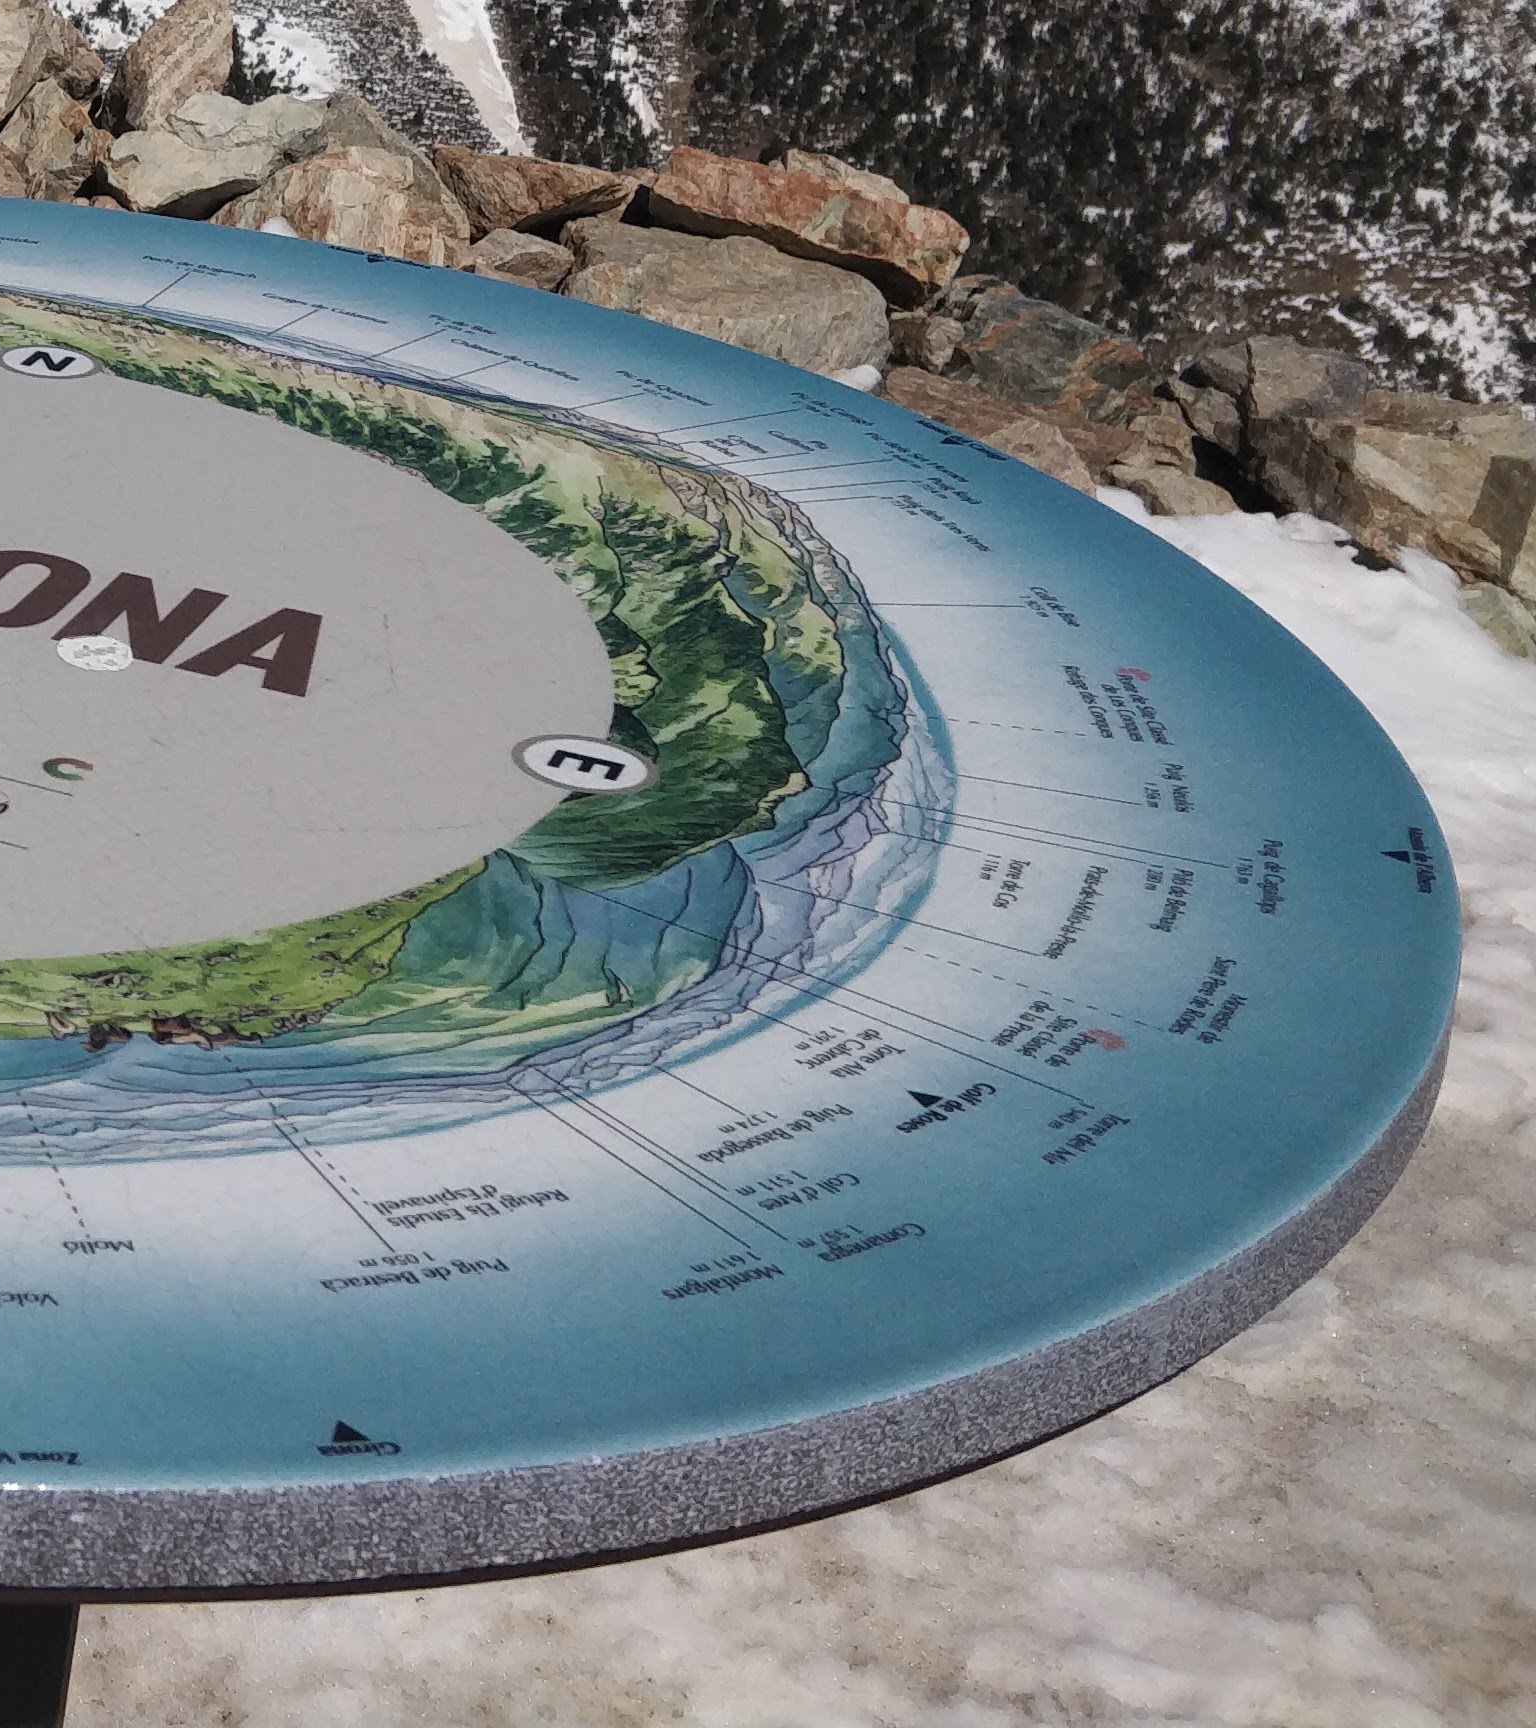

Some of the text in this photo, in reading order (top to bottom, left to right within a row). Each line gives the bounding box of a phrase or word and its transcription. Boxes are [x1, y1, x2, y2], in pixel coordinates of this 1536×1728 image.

[21, 351, 77, 373] N
[548, 743, 624, 786] E
[992, 859, 1031, 908] Torre de Cos
[808, 1031, 836, 1045] 291
[990, 1001, 1055, 1046] de la Preste
[1046, 1015, 1078, 1032] Site
[794, 1029, 883, 1069] de Cabrenç
[830, 1044, 905, 1079] Torre Alta
[1044, 1032, 1099, 1067] Porte de
[735, 1114, 767, 1129] 374
[896, 1083, 996, 1133] Golf de Roses
[1086, 1113, 1131, 1136] Torre
[696, 1104, 853, 1163] Puig de Bassegoda
[1065, 1134, 1096, 1153] del
[758, 1174, 794, 1191] 511
[758, 1173, 860, 1210] Coll d'Ares
[372, 1185, 506, 1216] d'Espinavell
[382, 1189, 569, 1228] Refugi Els Estudis
[62, 1240, 134, 1254] Molló
[381, 1254, 420, 1266] 056
[817, 1223, 927, 1262] Comanegra
[320, 1258, 510, 1292] Puig de Bestracà
[661, 1264, 785, 1300] Montfalgars
